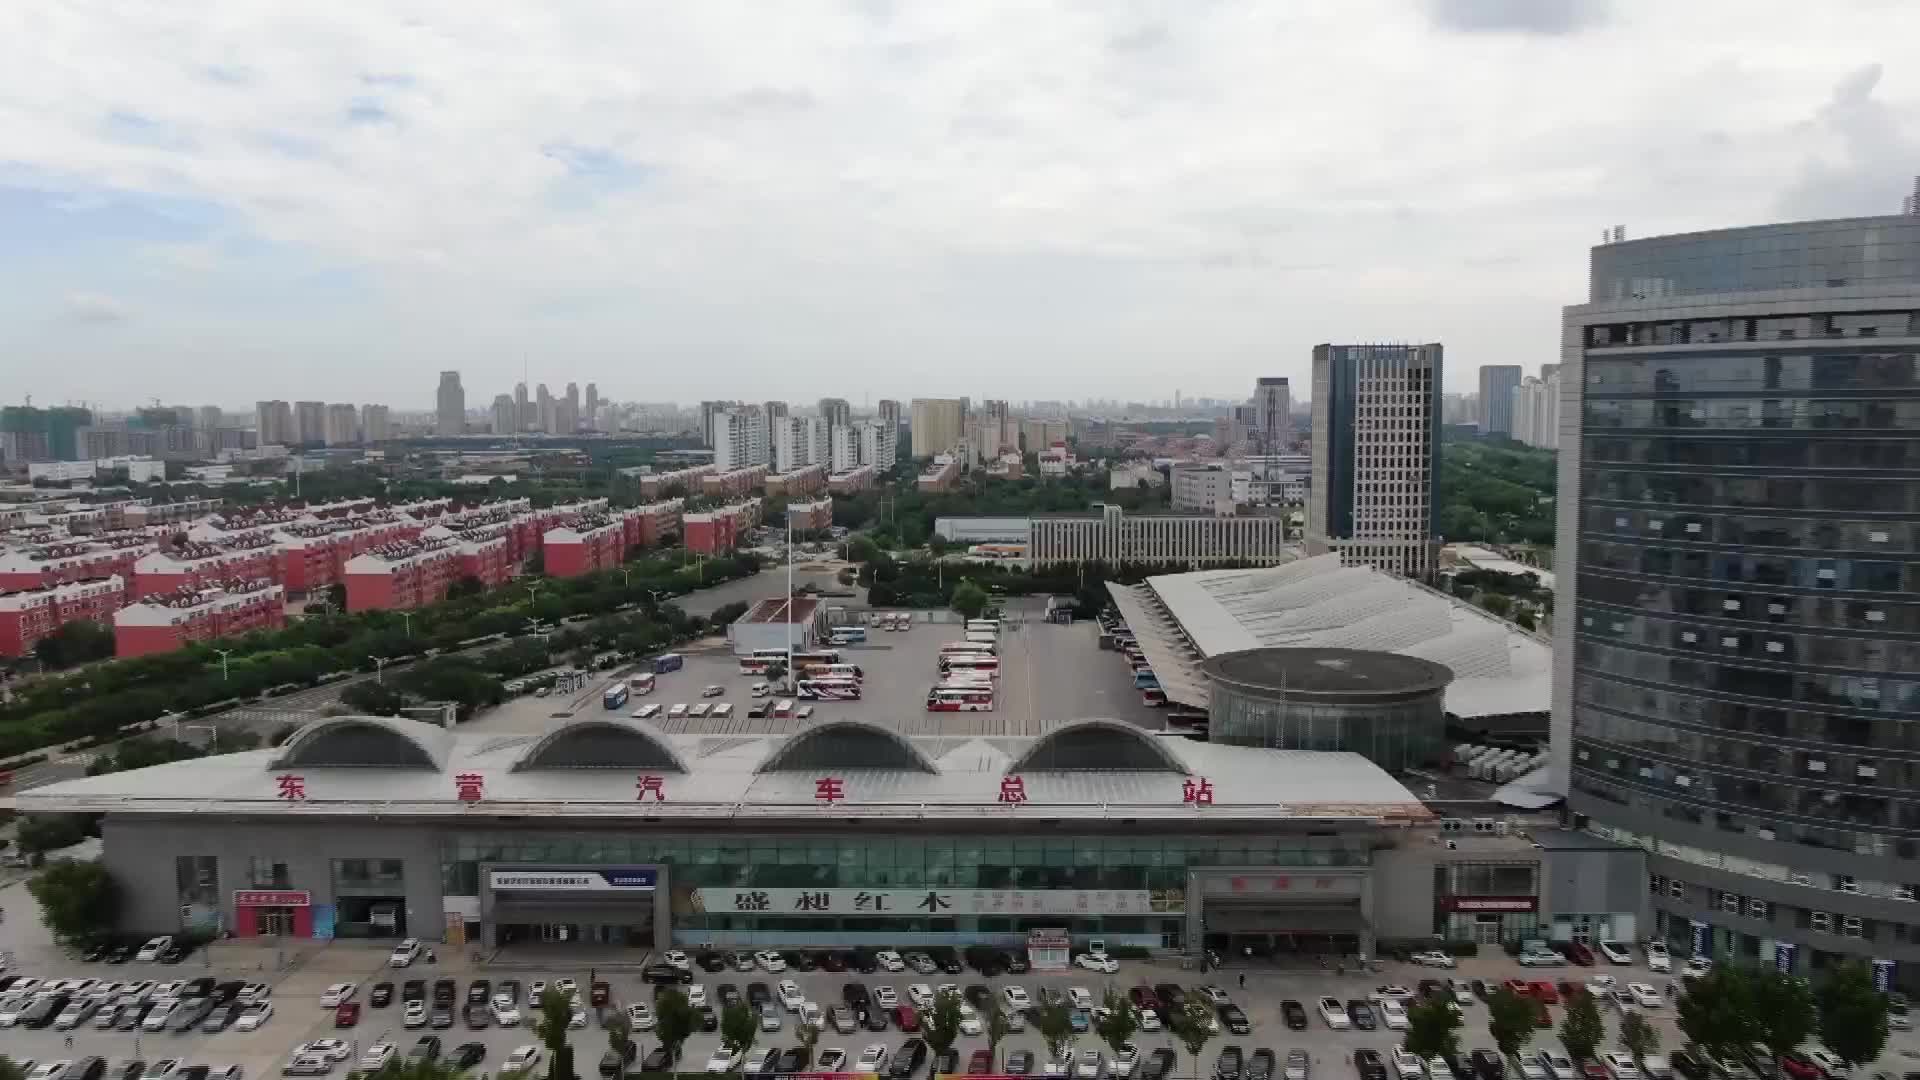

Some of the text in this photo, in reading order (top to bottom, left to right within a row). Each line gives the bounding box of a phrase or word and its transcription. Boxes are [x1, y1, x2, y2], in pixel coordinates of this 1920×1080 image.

[276, 775, 1213, 803] 东营汽车总站
